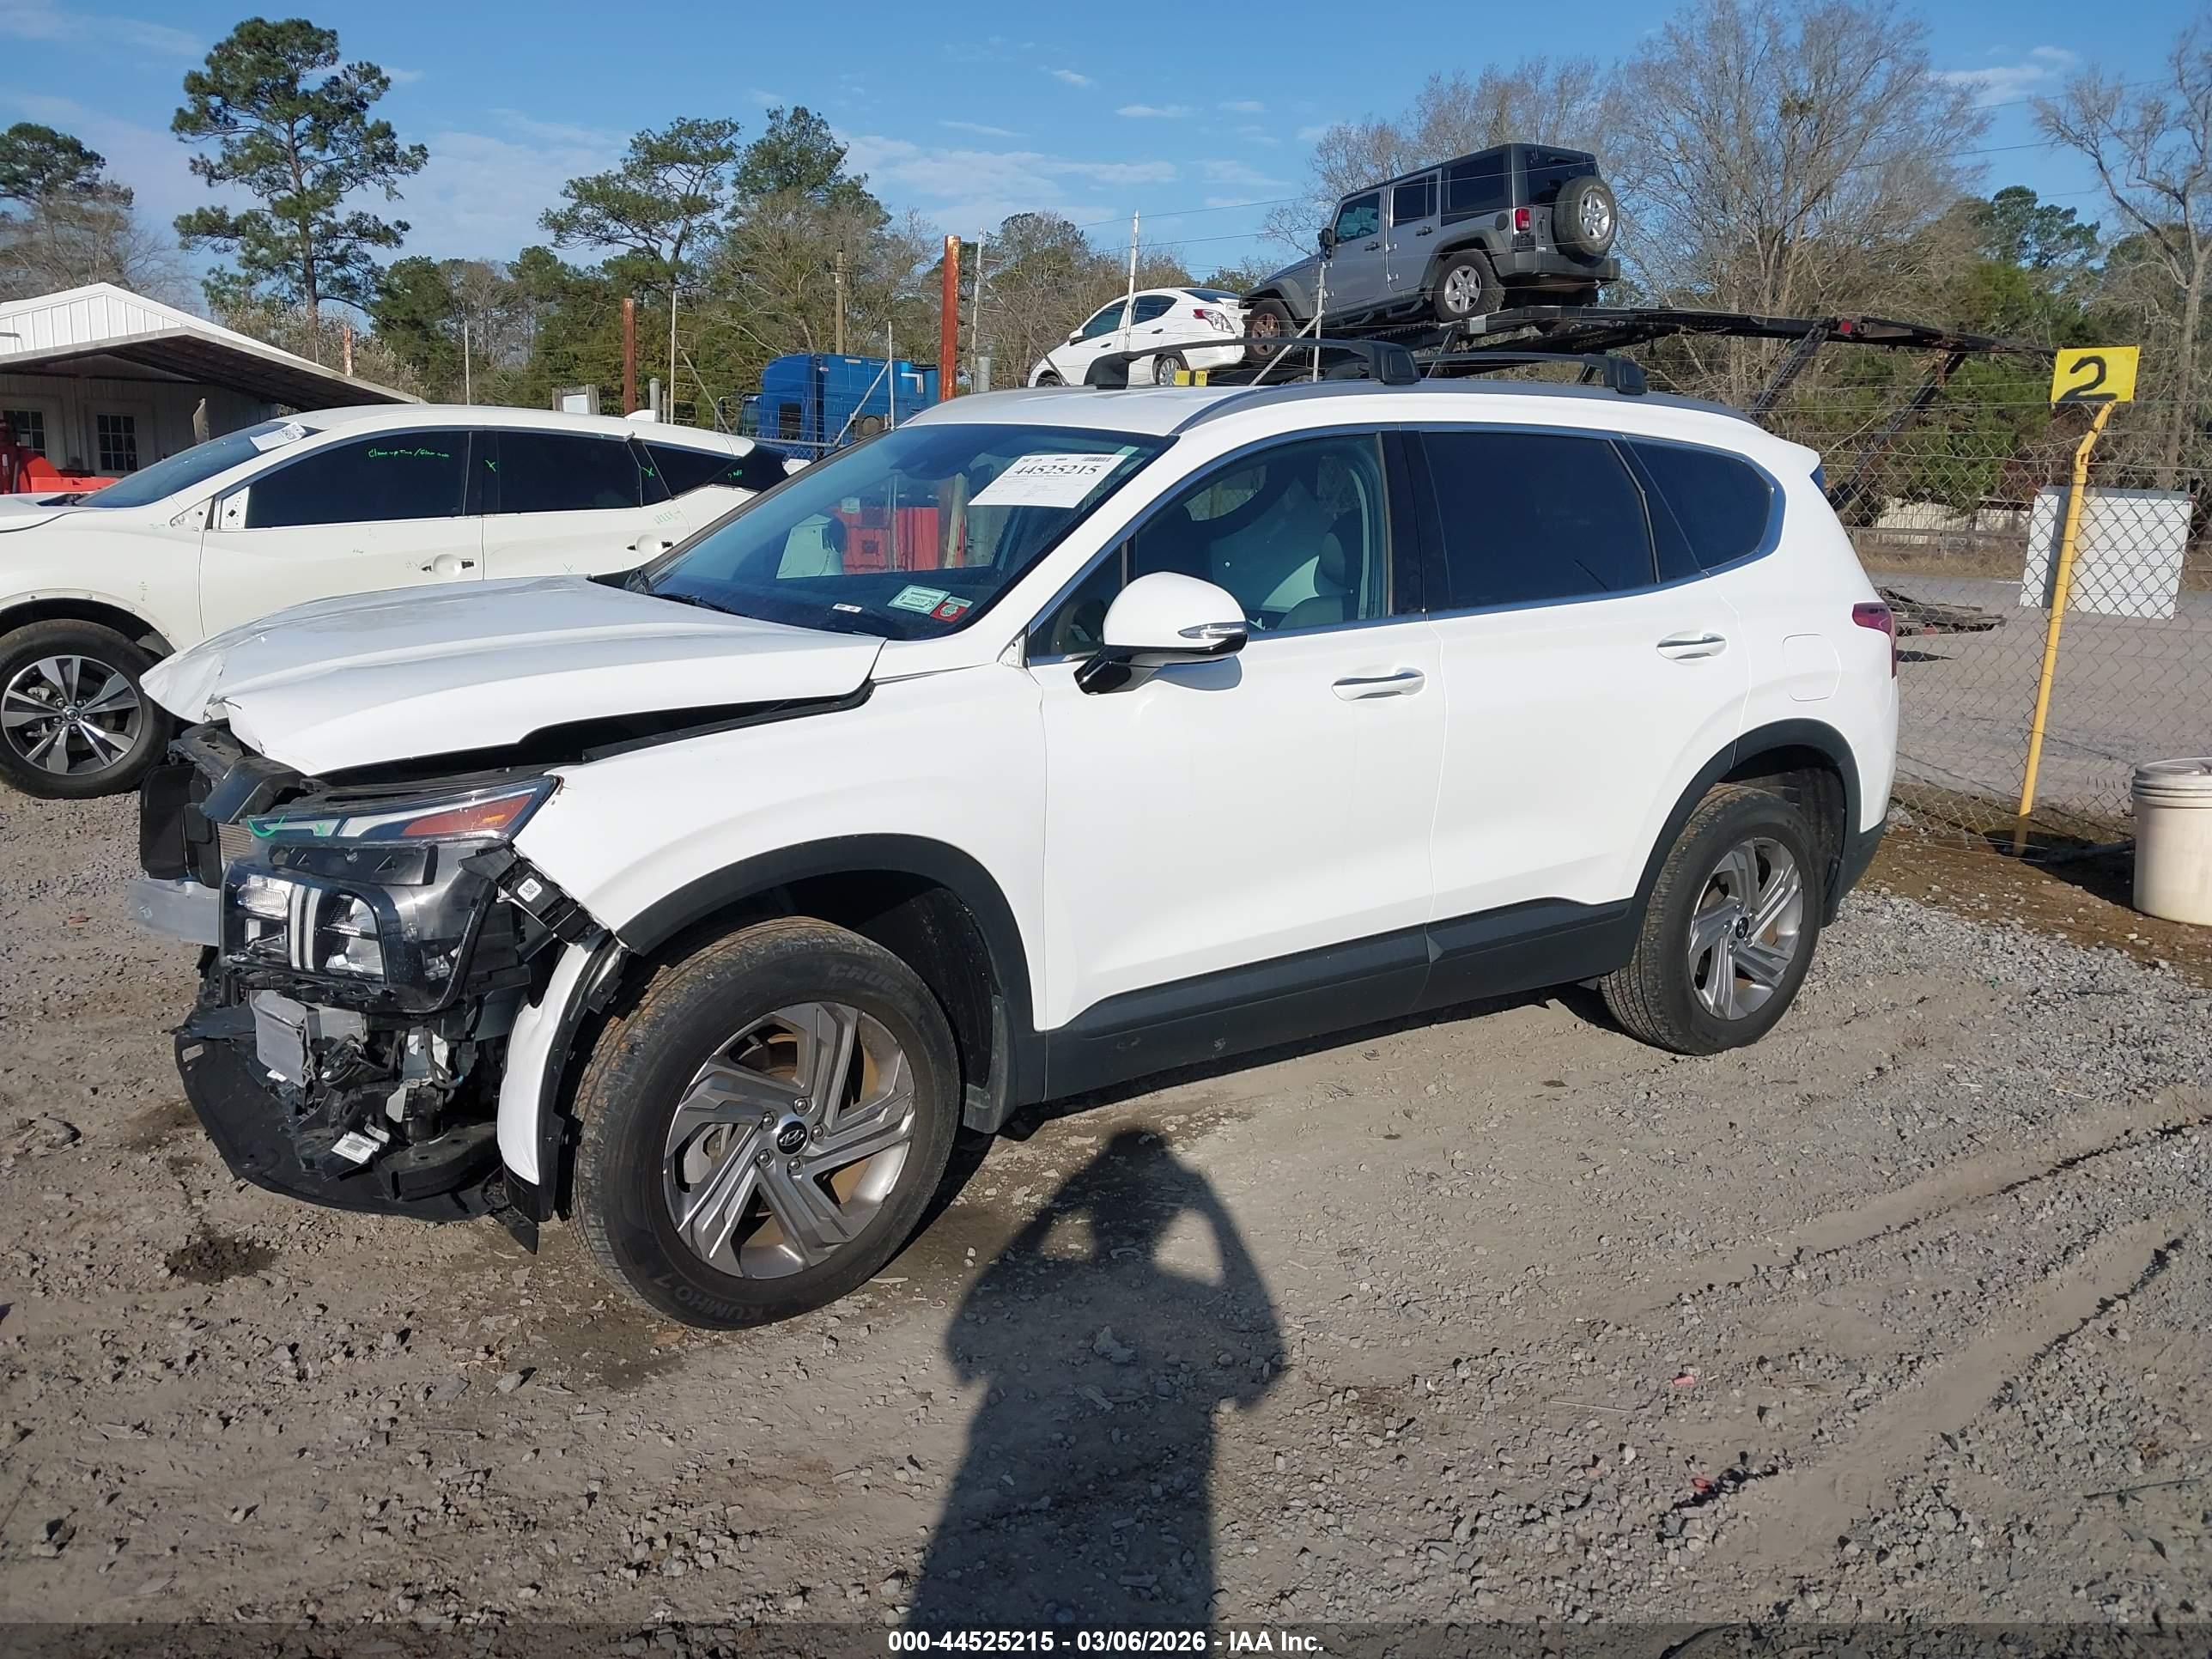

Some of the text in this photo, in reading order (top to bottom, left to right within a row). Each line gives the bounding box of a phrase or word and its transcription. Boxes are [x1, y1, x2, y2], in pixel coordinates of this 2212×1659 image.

[2057, 356, 2118, 402] 2
[1013, 465, 1102, 476] 44525215
[675, 1285, 764, 1321] KUMHO
